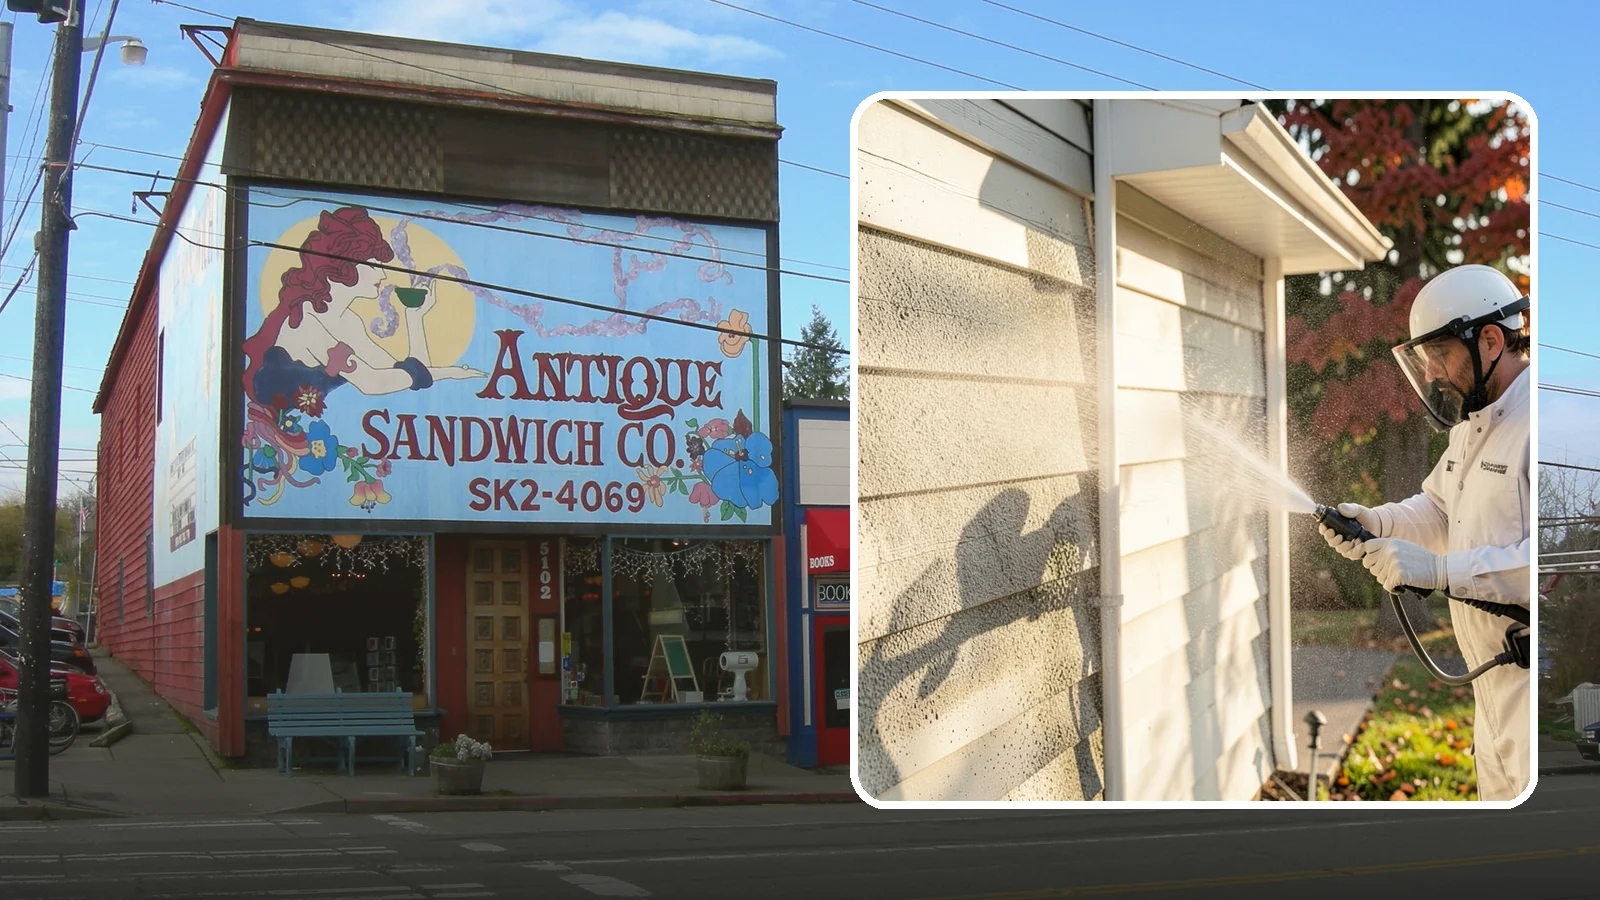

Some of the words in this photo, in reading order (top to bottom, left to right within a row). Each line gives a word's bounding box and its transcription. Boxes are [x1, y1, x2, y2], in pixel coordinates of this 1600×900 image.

[475, 329, 724, 421] ANTIQUE
[361, 408, 605, 467] SANDWICH
[617, 421, 685, 469] CO.
[468, 477, 646, 513] SK2-4069
[539, 541, 552, 600] 5102
[809, 555, 835, 569] BOOKS
